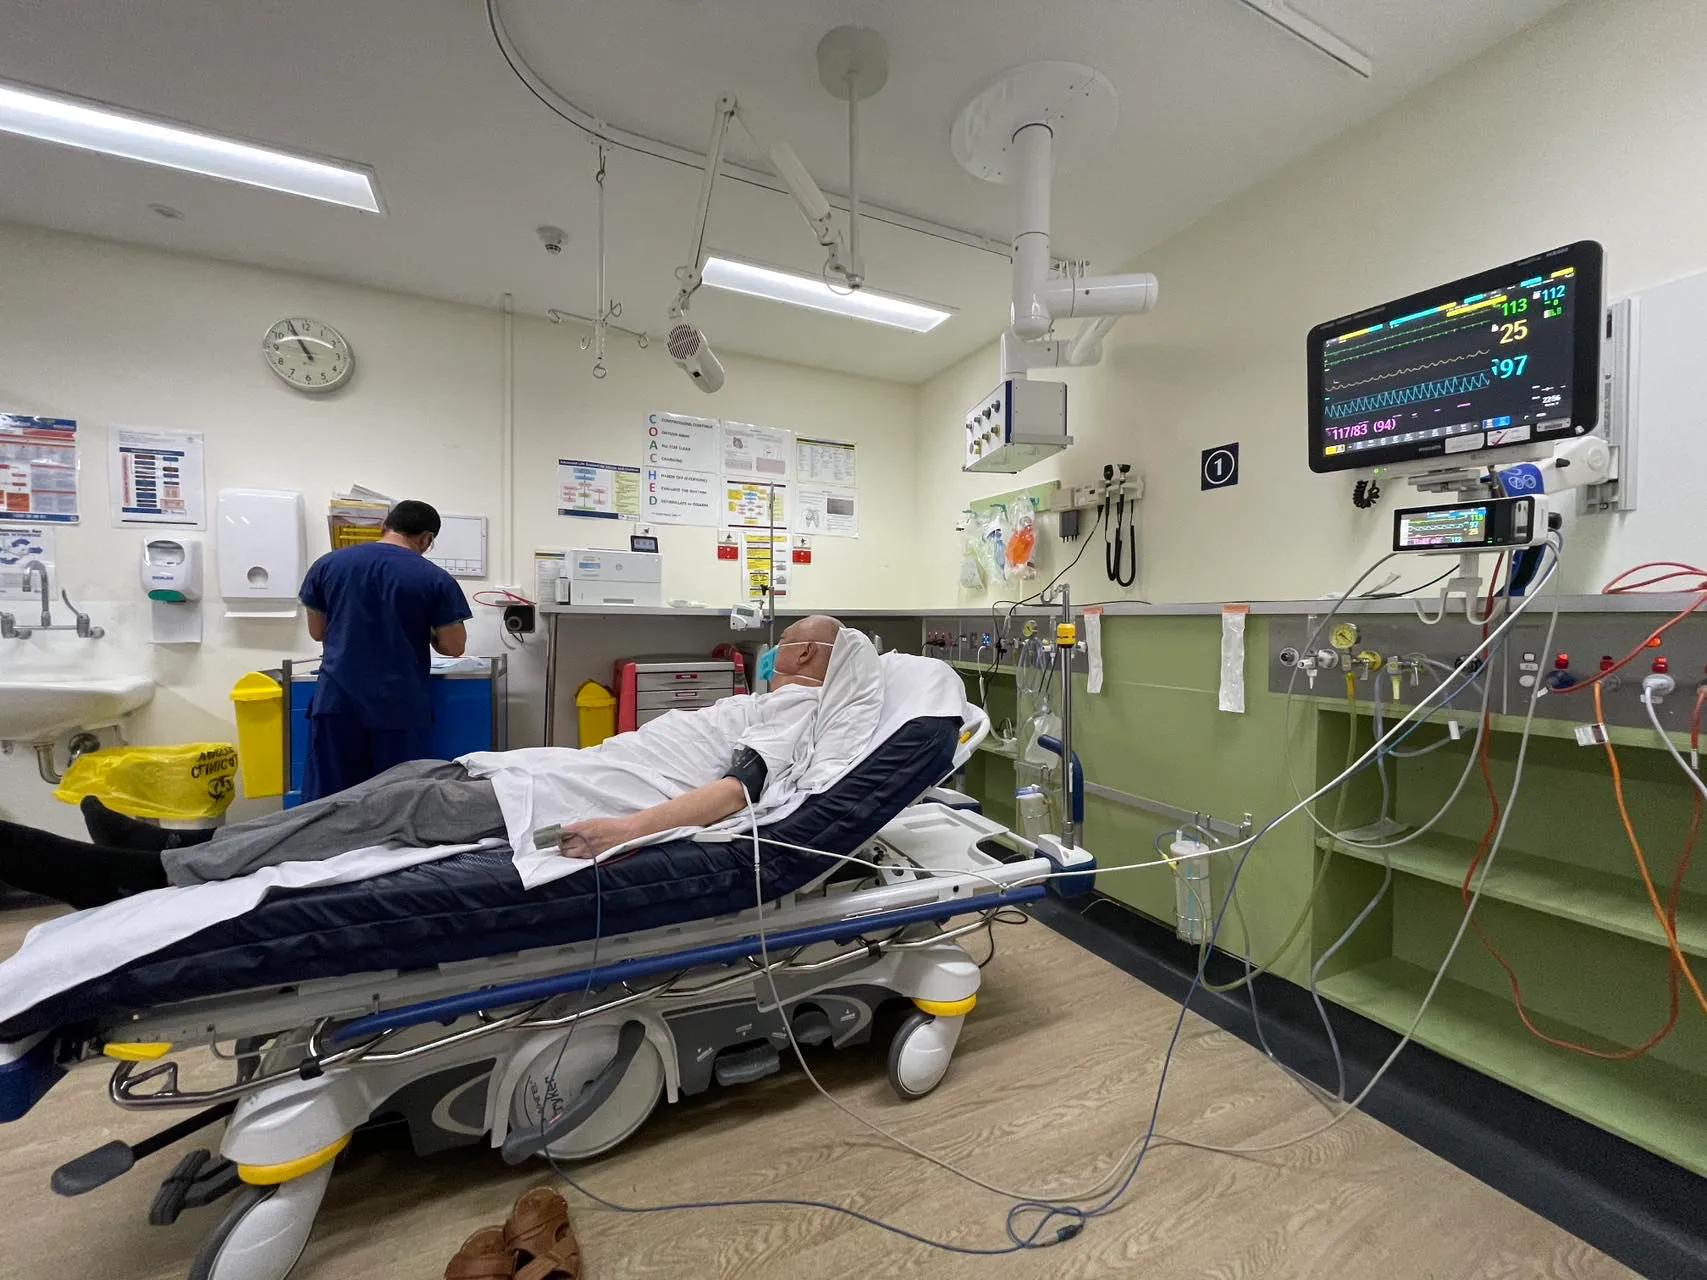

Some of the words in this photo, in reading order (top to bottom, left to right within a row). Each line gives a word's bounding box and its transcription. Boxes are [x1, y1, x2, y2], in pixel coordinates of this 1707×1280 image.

[1541, 285, 1566, 300] 112
[1502, 298, 1528, 316] 113
[302, 322, 310, 332] 12
[1500, 319, 1528, 344] 25
[1500, 354, 1528, 379] 97
[649, 414, 656, 424] C
[649, 426, 658, 436] O
[1332, 423, 1368, 440] 117/83
[1373, 419, 1396, 432] (94)
[649, 440, 658, 450] A
[650, 453, 657, 462] C
[1214, 458, 1222, 476] 1
[648, 470, 656, 480] H
[649, 482, 656, 492] E
[649, 496, 658, 506] D
